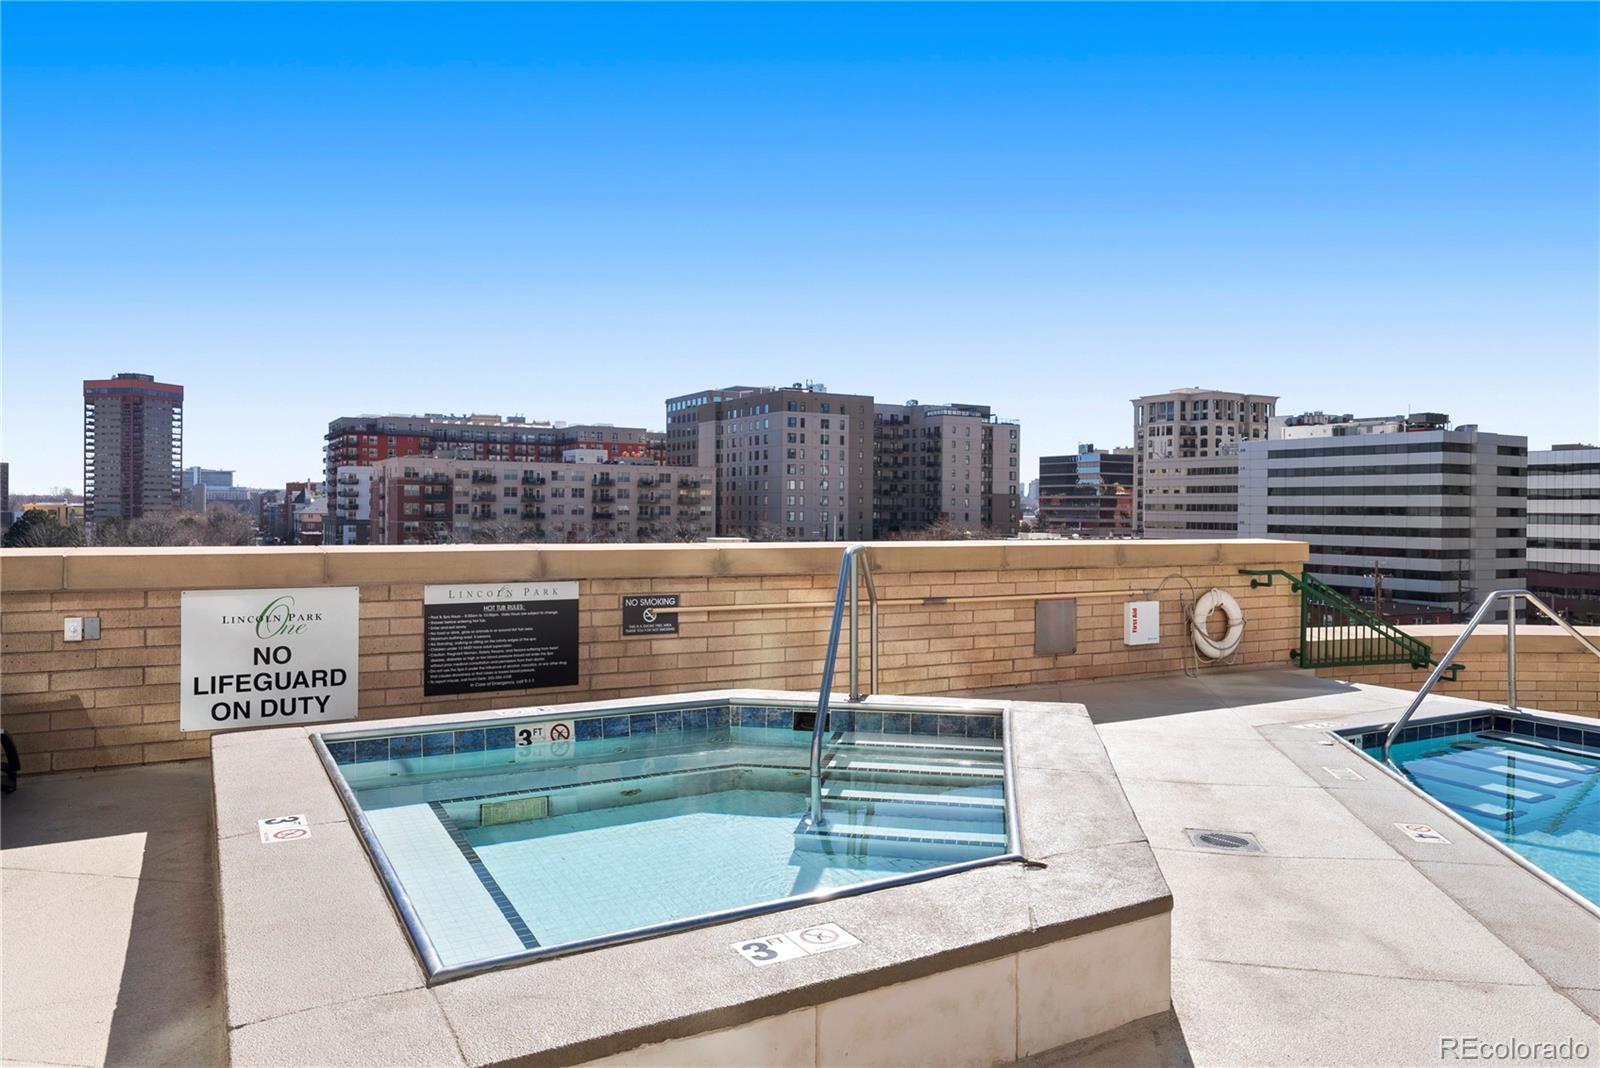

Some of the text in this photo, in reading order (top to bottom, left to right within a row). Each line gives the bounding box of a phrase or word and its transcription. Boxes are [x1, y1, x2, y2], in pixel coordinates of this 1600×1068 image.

[448, 587, 559, 599] LINCOLN PARK
[626, 598, 676, 606] NO SMOKING
[222, 612, 323, 624] LINCOLN PARK
[256, 596, 308, 640] One
[254, 646, 292, 666] NO
[194, 668, 347, 696] LIFEGUARD
[211, 695, 331, 721] ON DUTY
[519, 729, 532, 746] 3
[742, 936, 784, 960] 3 FT
